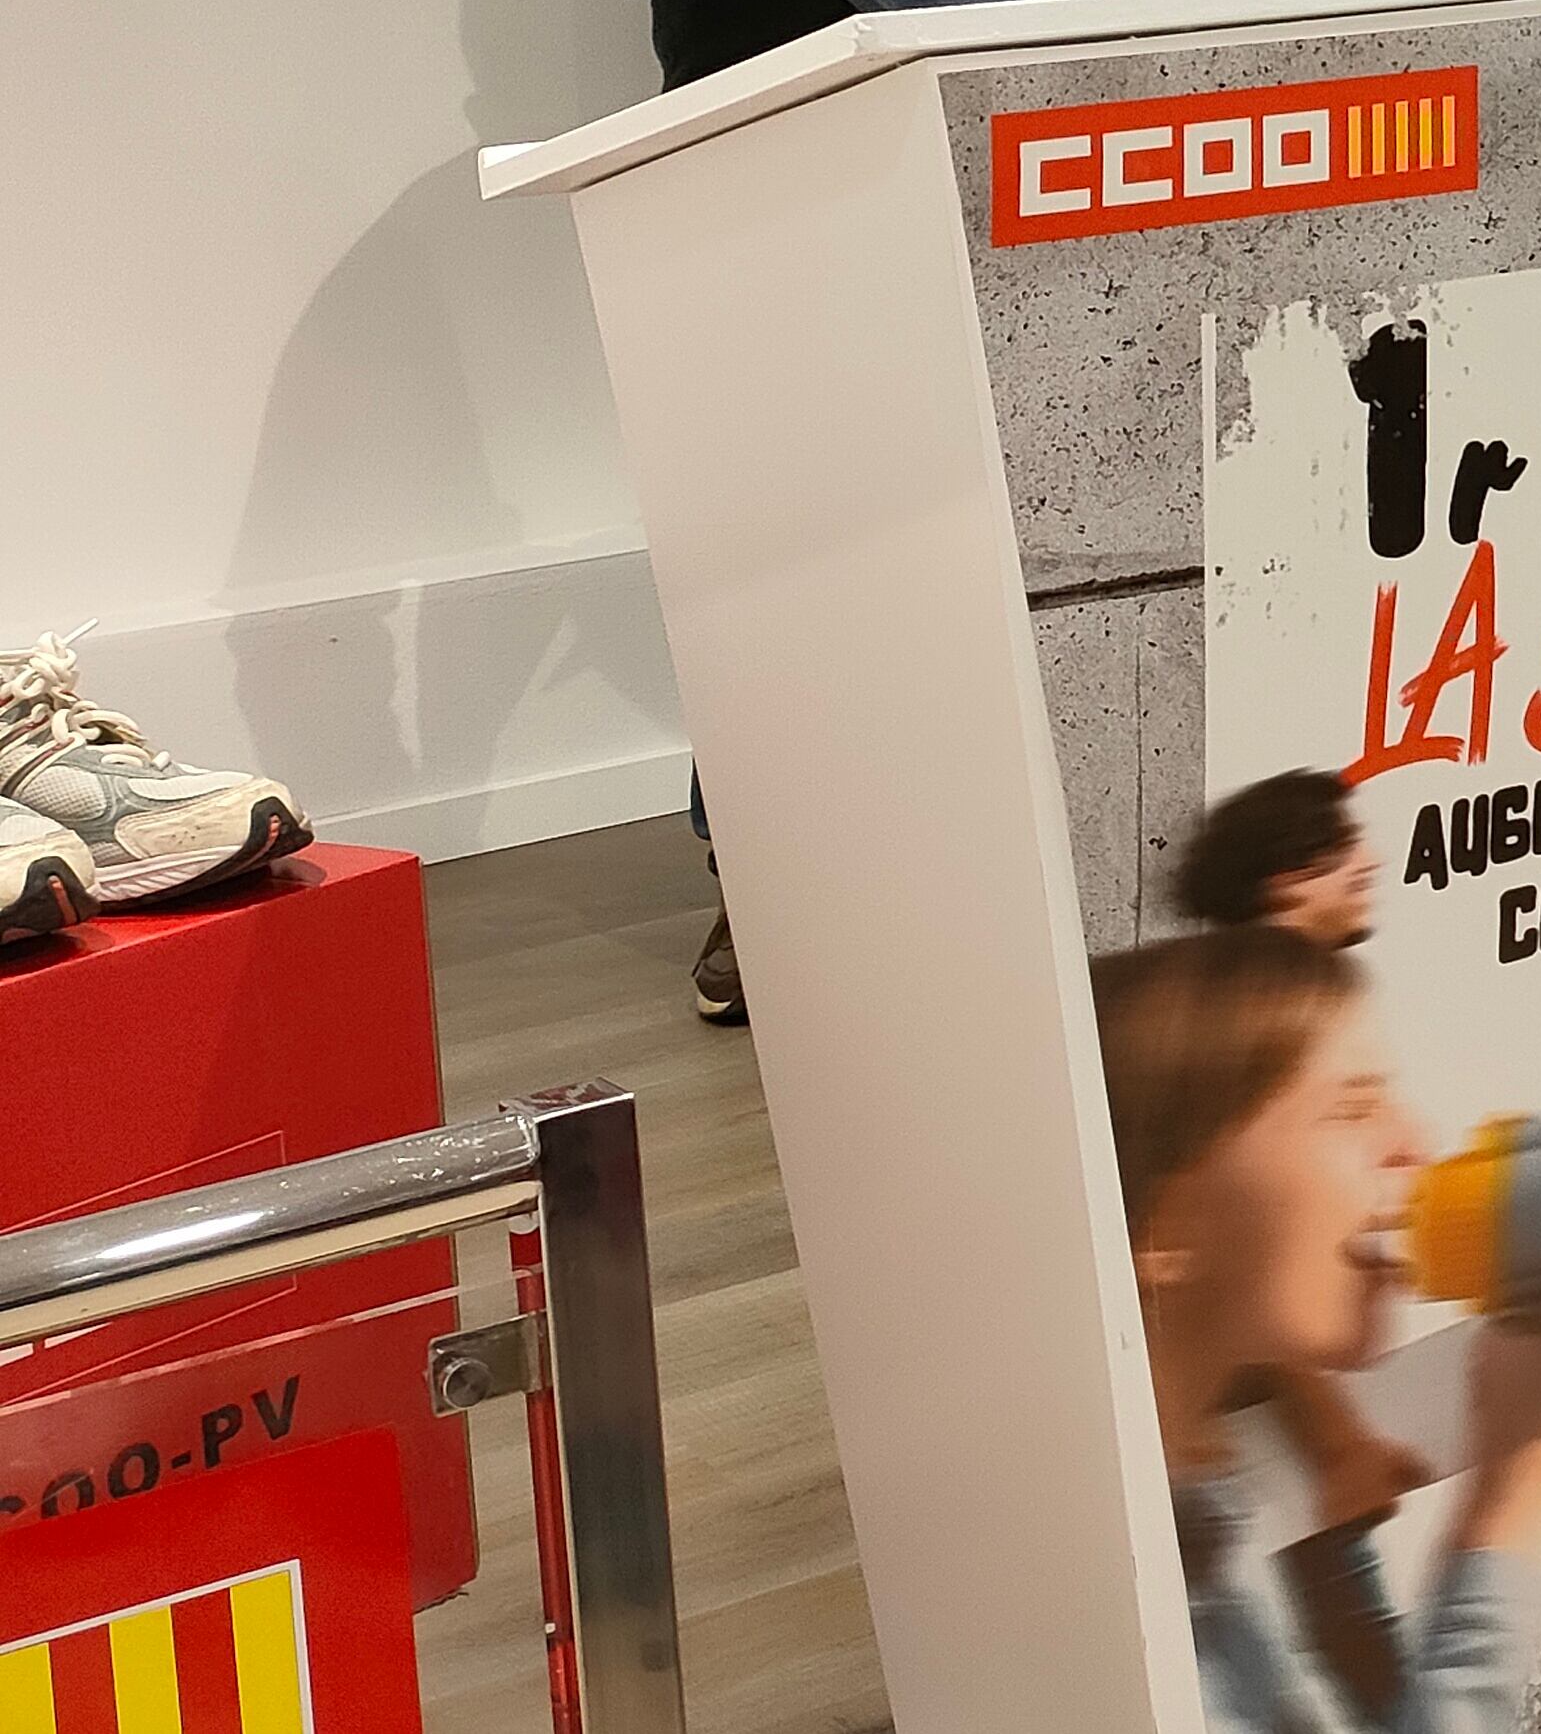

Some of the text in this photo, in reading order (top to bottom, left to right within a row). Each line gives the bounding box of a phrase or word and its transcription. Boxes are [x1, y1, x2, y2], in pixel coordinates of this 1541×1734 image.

[1018, 108, 1330, 217] CCOO
[1348, 319, 1528, 559] 1r
[1340, 539, 1511, 788] LA
